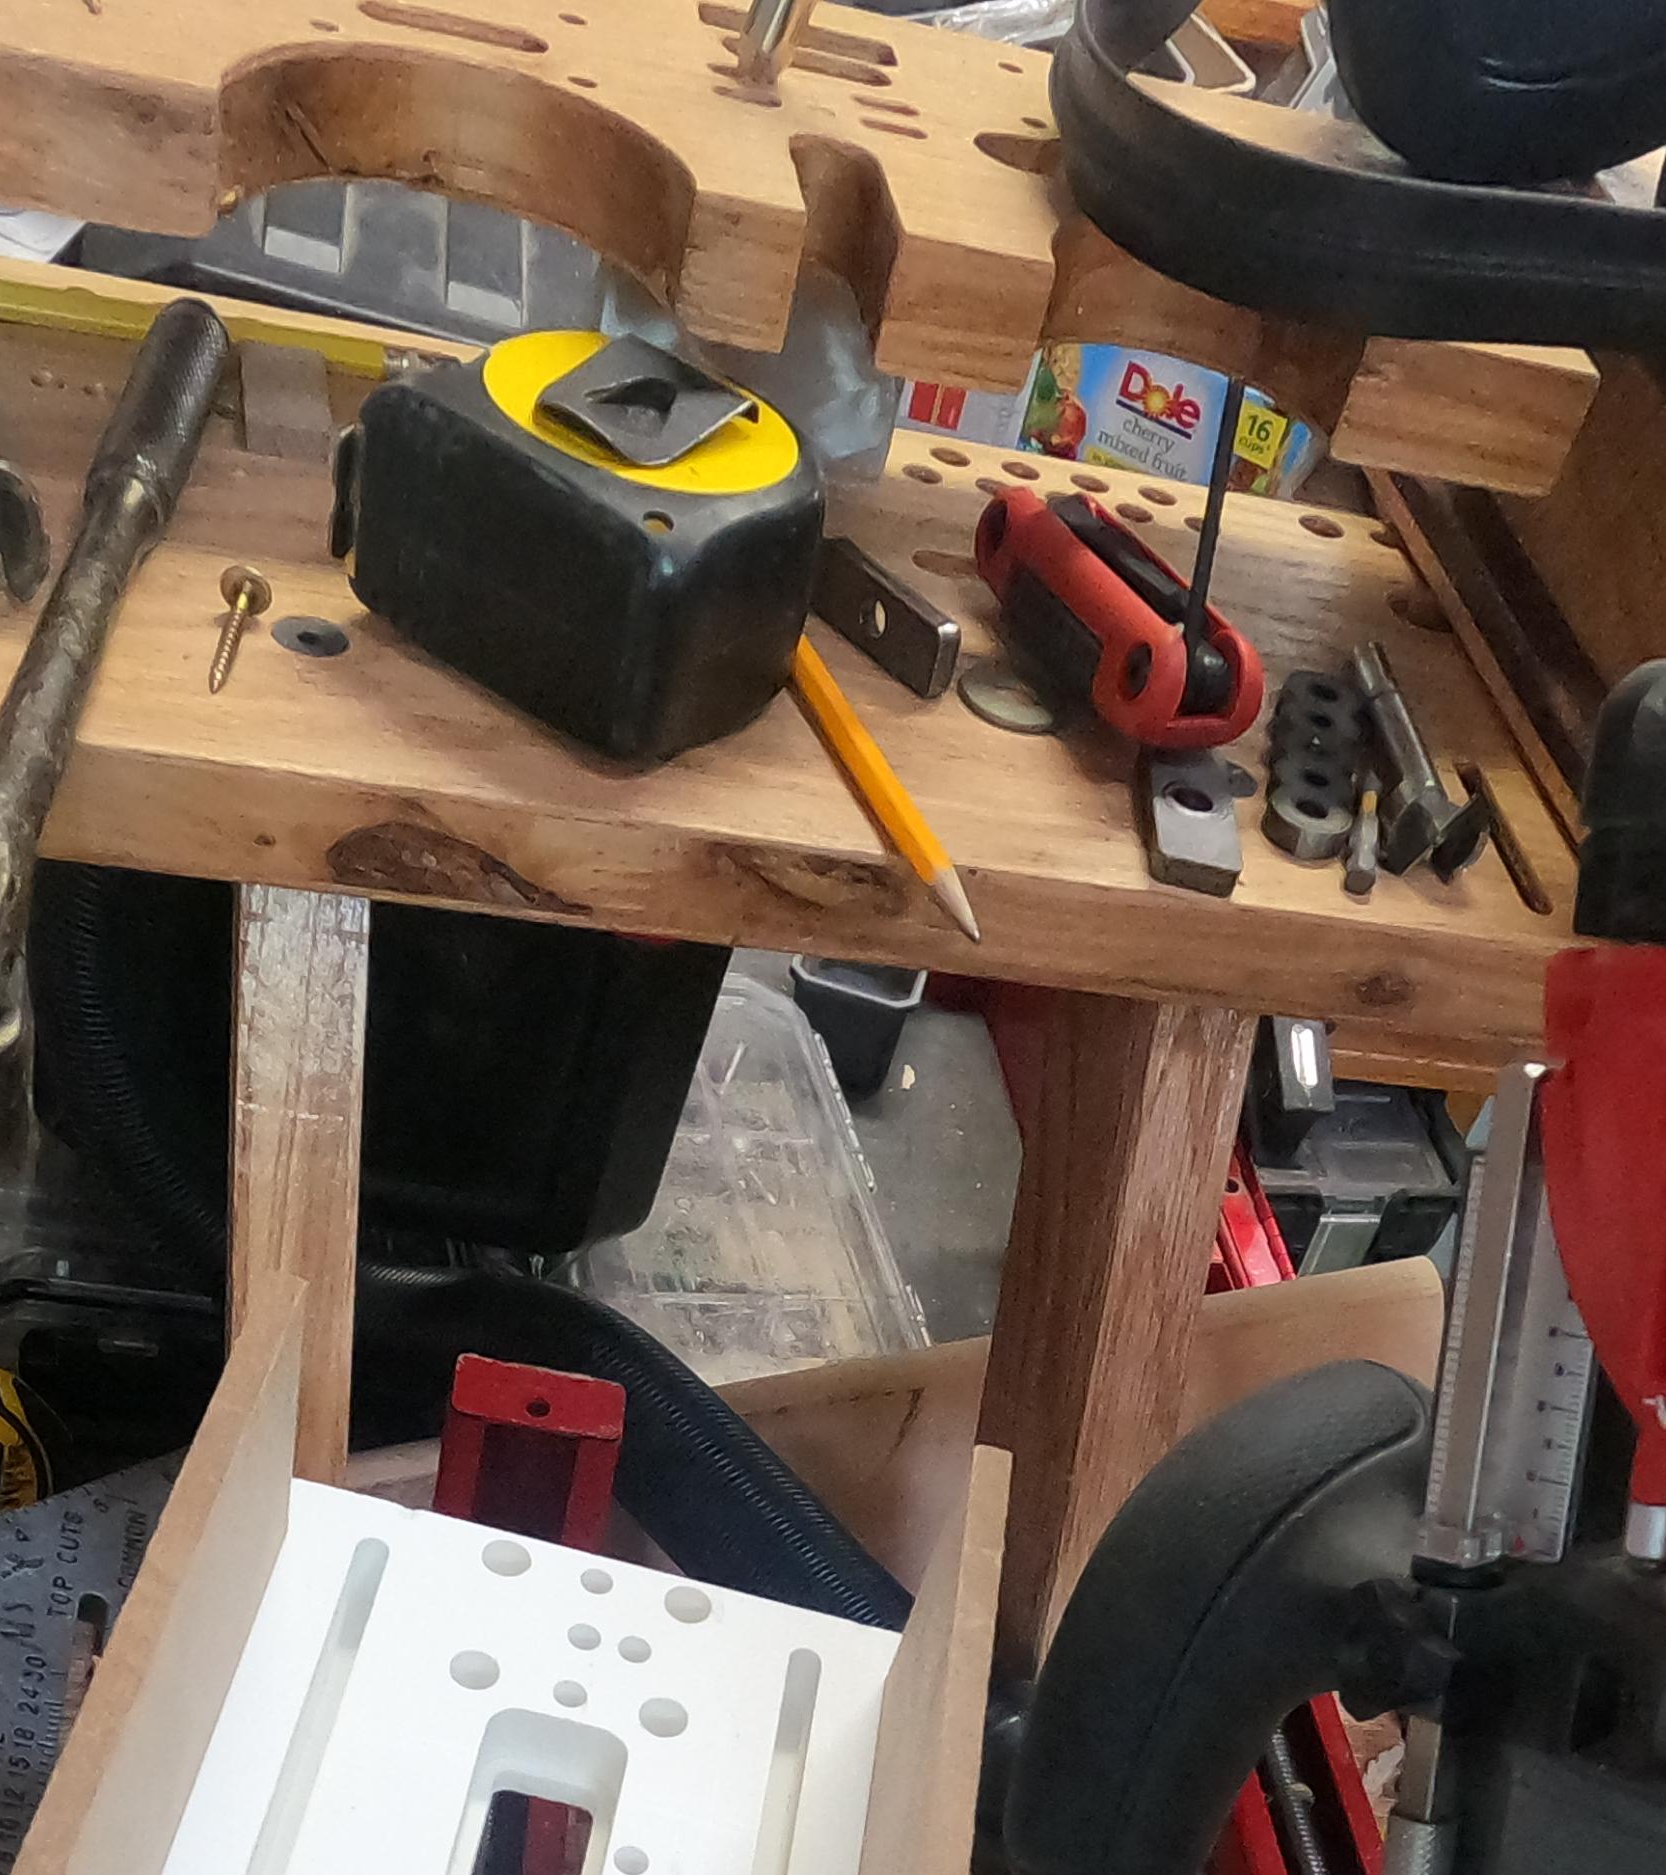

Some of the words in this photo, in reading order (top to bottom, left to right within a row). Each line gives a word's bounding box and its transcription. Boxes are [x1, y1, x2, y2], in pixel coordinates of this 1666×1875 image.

[1117, 360, 1202, 430] Dole
[1122, 417, 1176, 453] cherry
[1245, 413, 1274, 442] 16
[1097, 428, 1151, 463] mixed
[1151, 450, 1189, 482] fruit
[55, 1510, 84, 1565] CUTS
[45, 1575, 75, 1618] TOP
[18, 1686, 40, 1717] 24
[13, 1726, 36, 1751] 18
[7, 1755, 31, 1779] 15
[2, 1787, 26, 1809] 12
